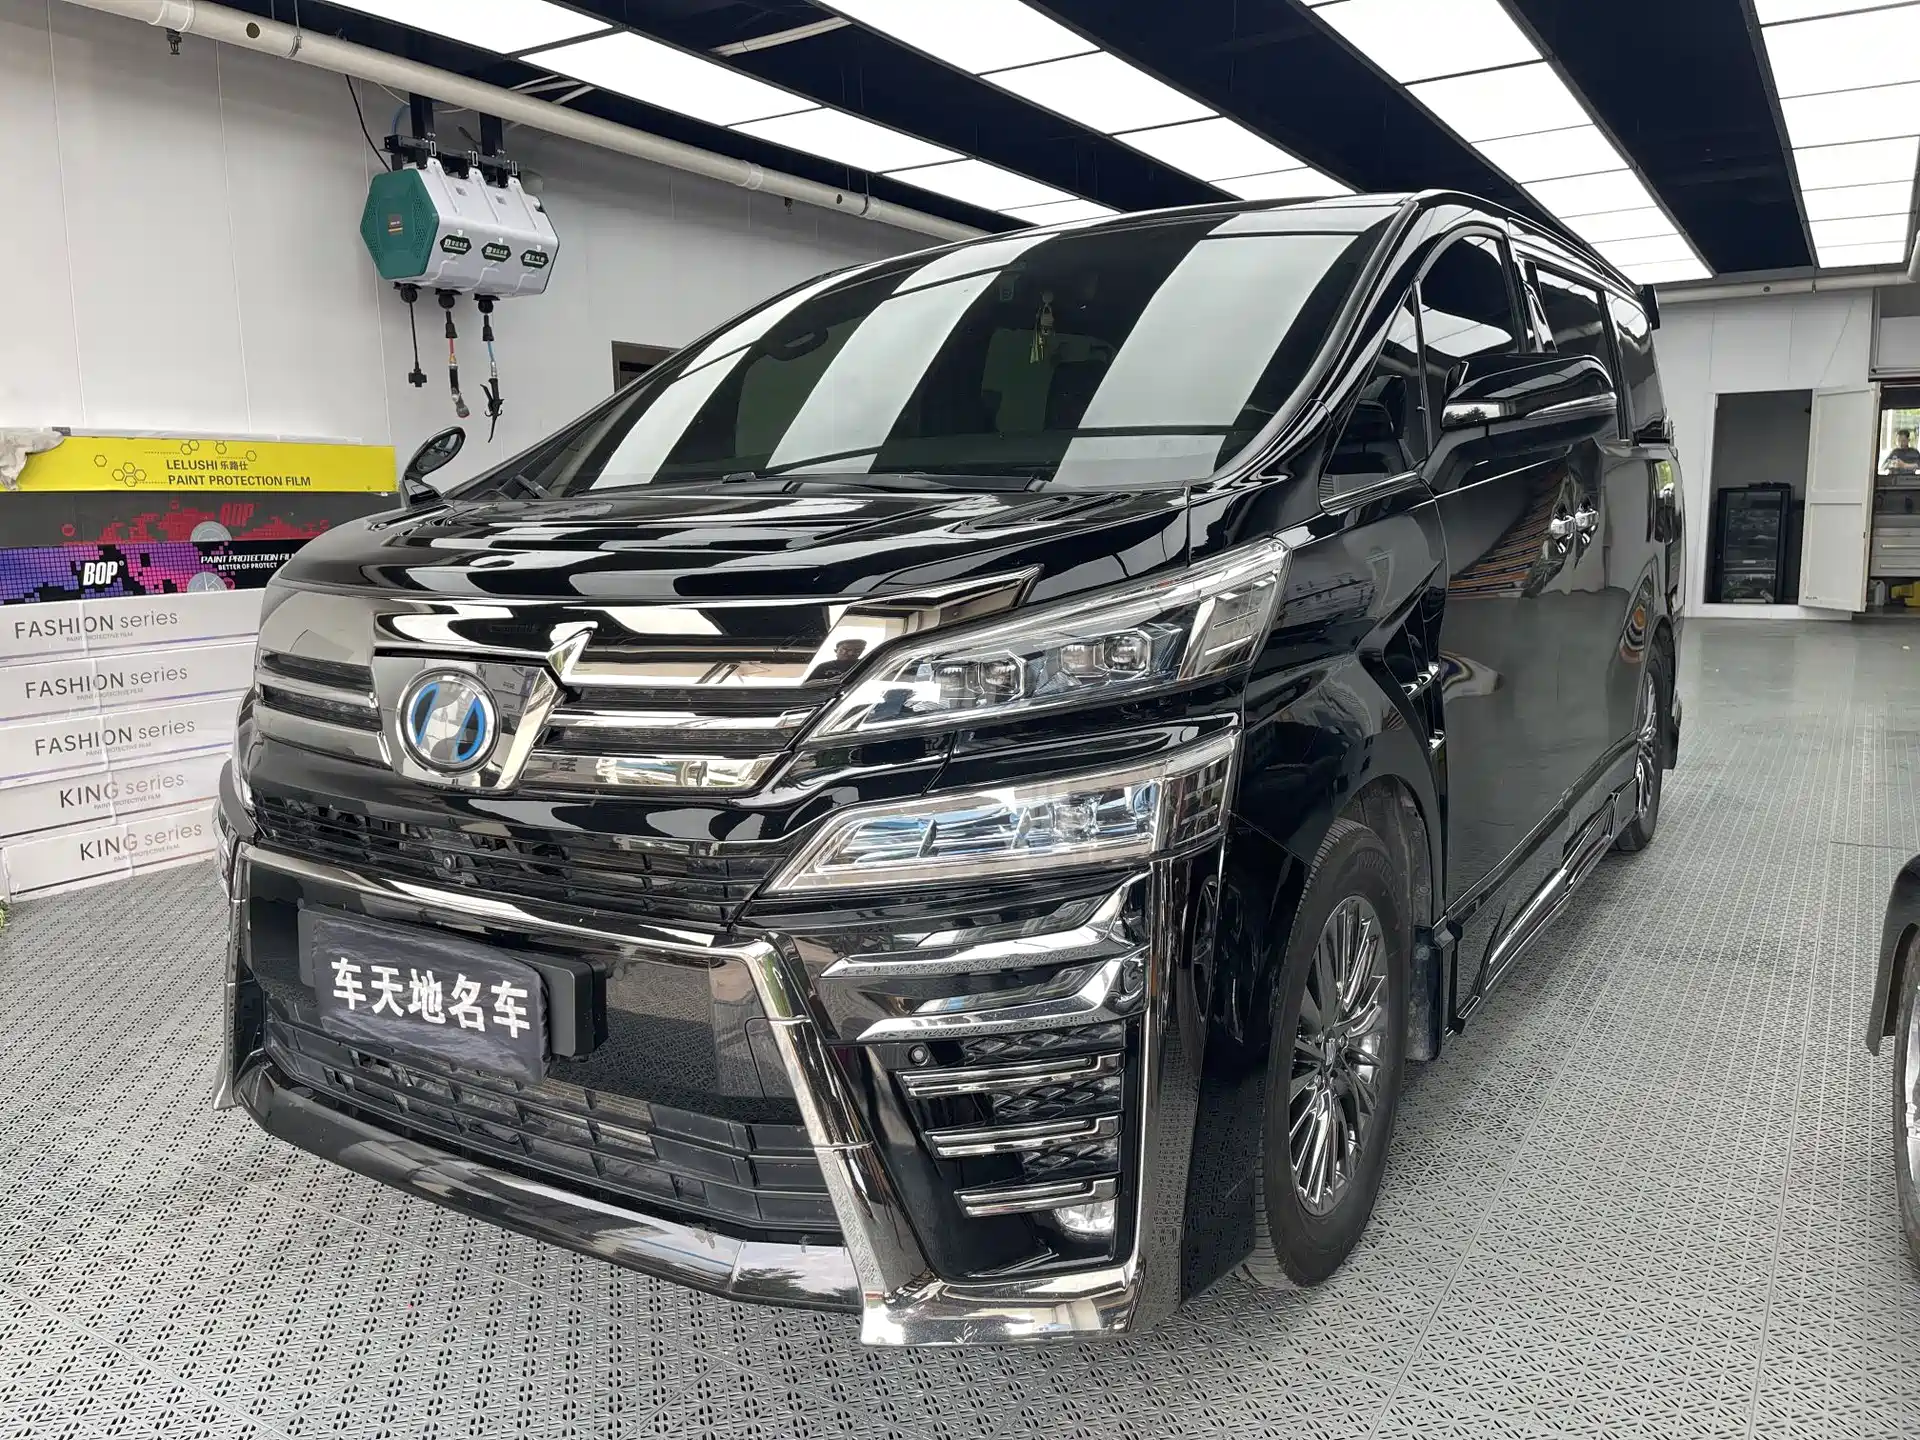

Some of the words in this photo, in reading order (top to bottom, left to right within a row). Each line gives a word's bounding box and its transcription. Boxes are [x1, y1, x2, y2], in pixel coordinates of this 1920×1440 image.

[166, 460, 218, 471] LELUSHI
[168, 475, 206, 486] PAINT
[209, 475, 283, 486] PROTECTION
[285, 476, 311, 486] FILM
[201, 555, 228, 564] PAINT
[228, 553, 279, 563] PROTECTION
[218, 562, 241, 571] BETTER
[241, 562, 250, 570] OF
[250, 562, 277, 570] PROTECT
[14, 614, 114, 639] FASHION
[120, 610, 178, 628] series
[25, 672, 124, 699] FASHION
[130, 666, 188, 685] series
[34, 726, 133, 756] FASHION
[138, 720, 195, 739] series
[60, 782, 119, 808] KING
[125, 774, 185, 795] series
[80, 833, 138, 861] KING
[144, 823, 202, 846] series
[331, 957, 531, 1039] 车天地名车
